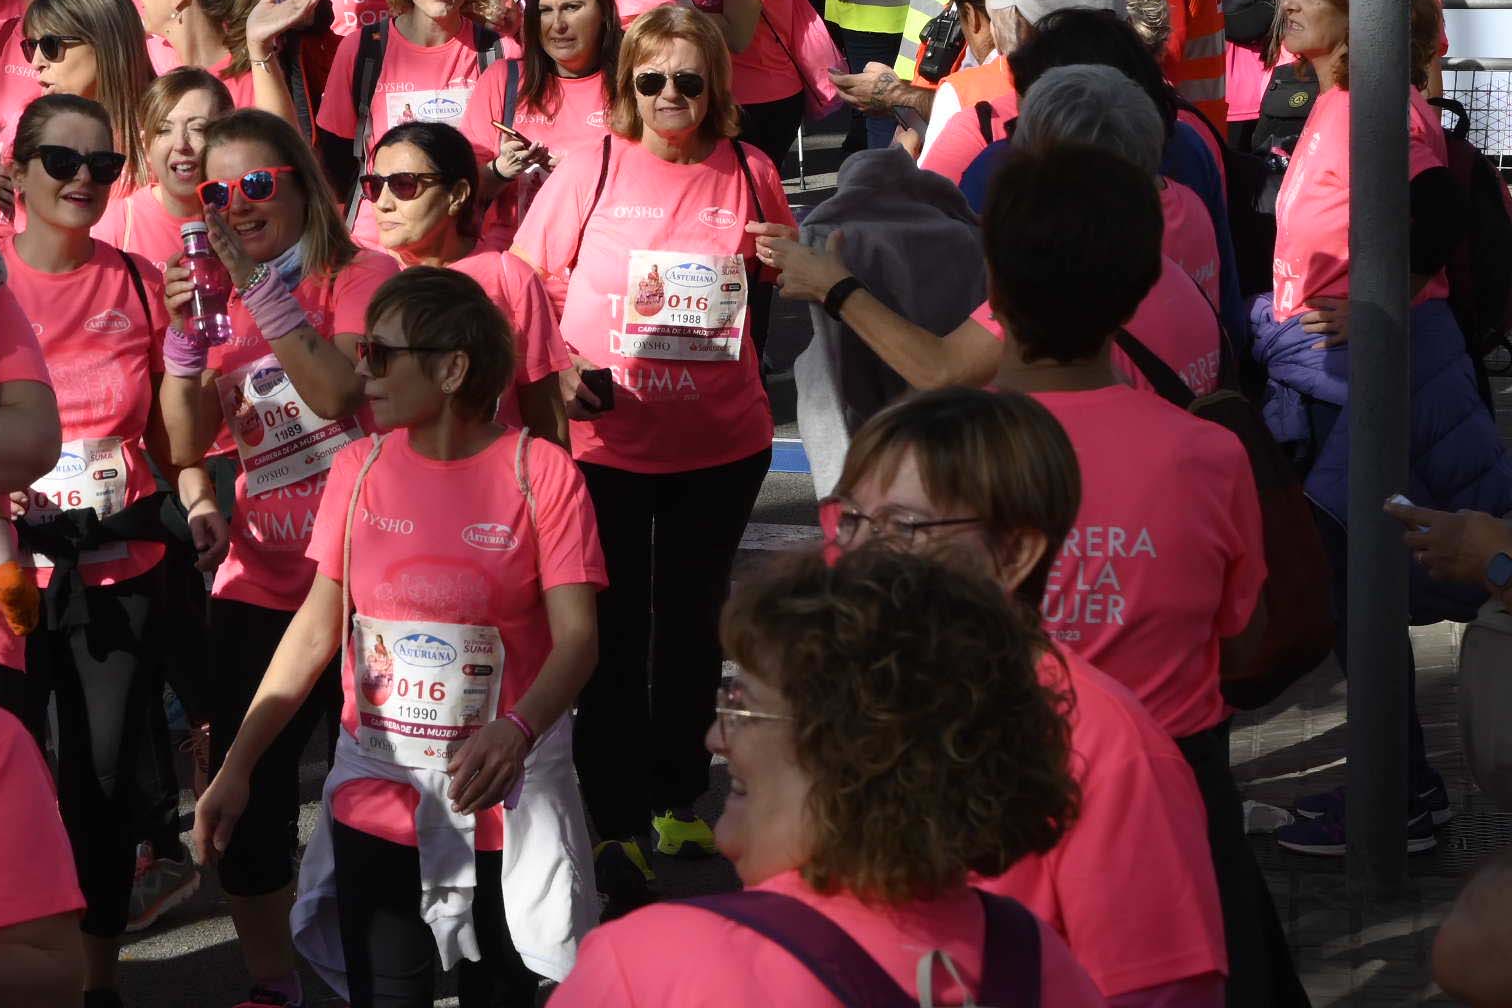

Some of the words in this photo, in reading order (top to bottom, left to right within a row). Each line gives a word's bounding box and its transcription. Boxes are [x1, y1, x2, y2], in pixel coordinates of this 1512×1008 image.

[668, 294, 709, 311] 016
[670, 314, 701, 324] 11988
[633, 341, 671, 351] OYSHO
[263, 401, 300, 427] 016
[1062, 527, 1157, 558] RERA
[1046, 561, 1062, 591] E
[1076, 560, 1121, 592] LA
[1042, 594, 1126, 625] UJER
[464, 645, 493, 654] SUMA
[397, 678, 446, 701] 016
[399, 706, 437, 721] 11990
[413, 727, 425, 735] LA
[427, 729, 458, 738] MUJER
